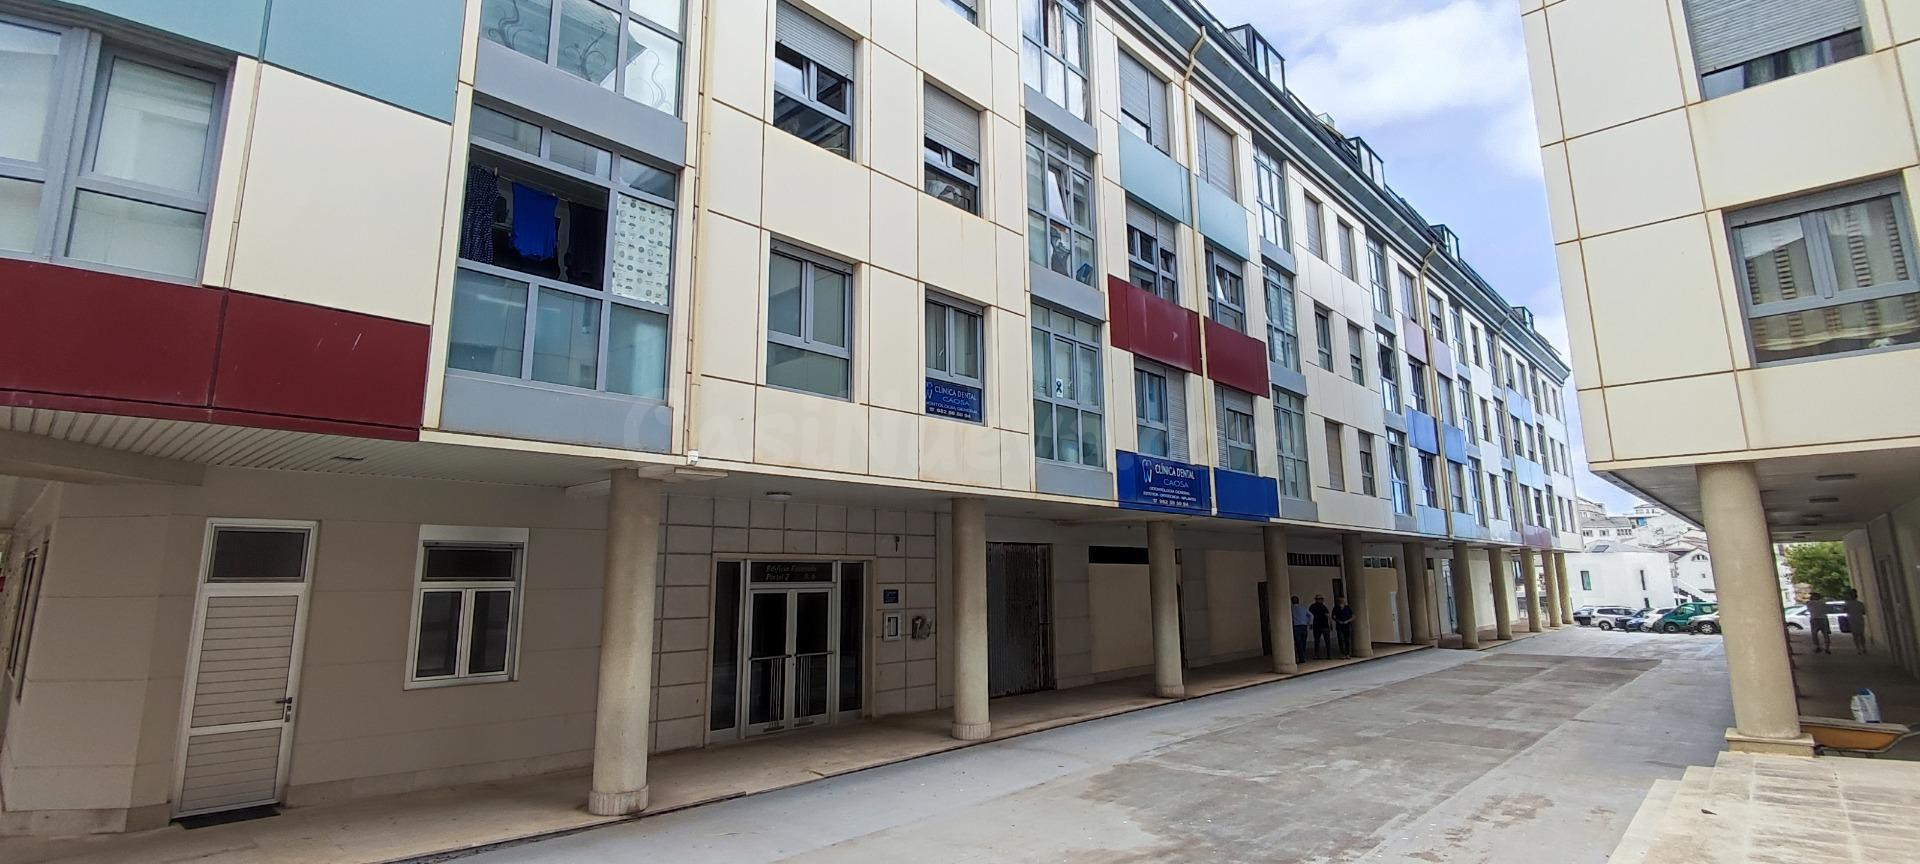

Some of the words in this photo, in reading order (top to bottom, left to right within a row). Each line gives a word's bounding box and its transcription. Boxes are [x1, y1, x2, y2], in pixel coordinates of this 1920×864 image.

[935, 385, 956, 396] CLÍNICA
[957, 391, 977, 401] DENTAL
[943, 397, 969, 406] CAOSA
[1155, 463, 1176, 477] CLÍNICA
[1177, 468, 1195, 480] DENTAL
[1164, 479, 1189, 488] CAOSA
